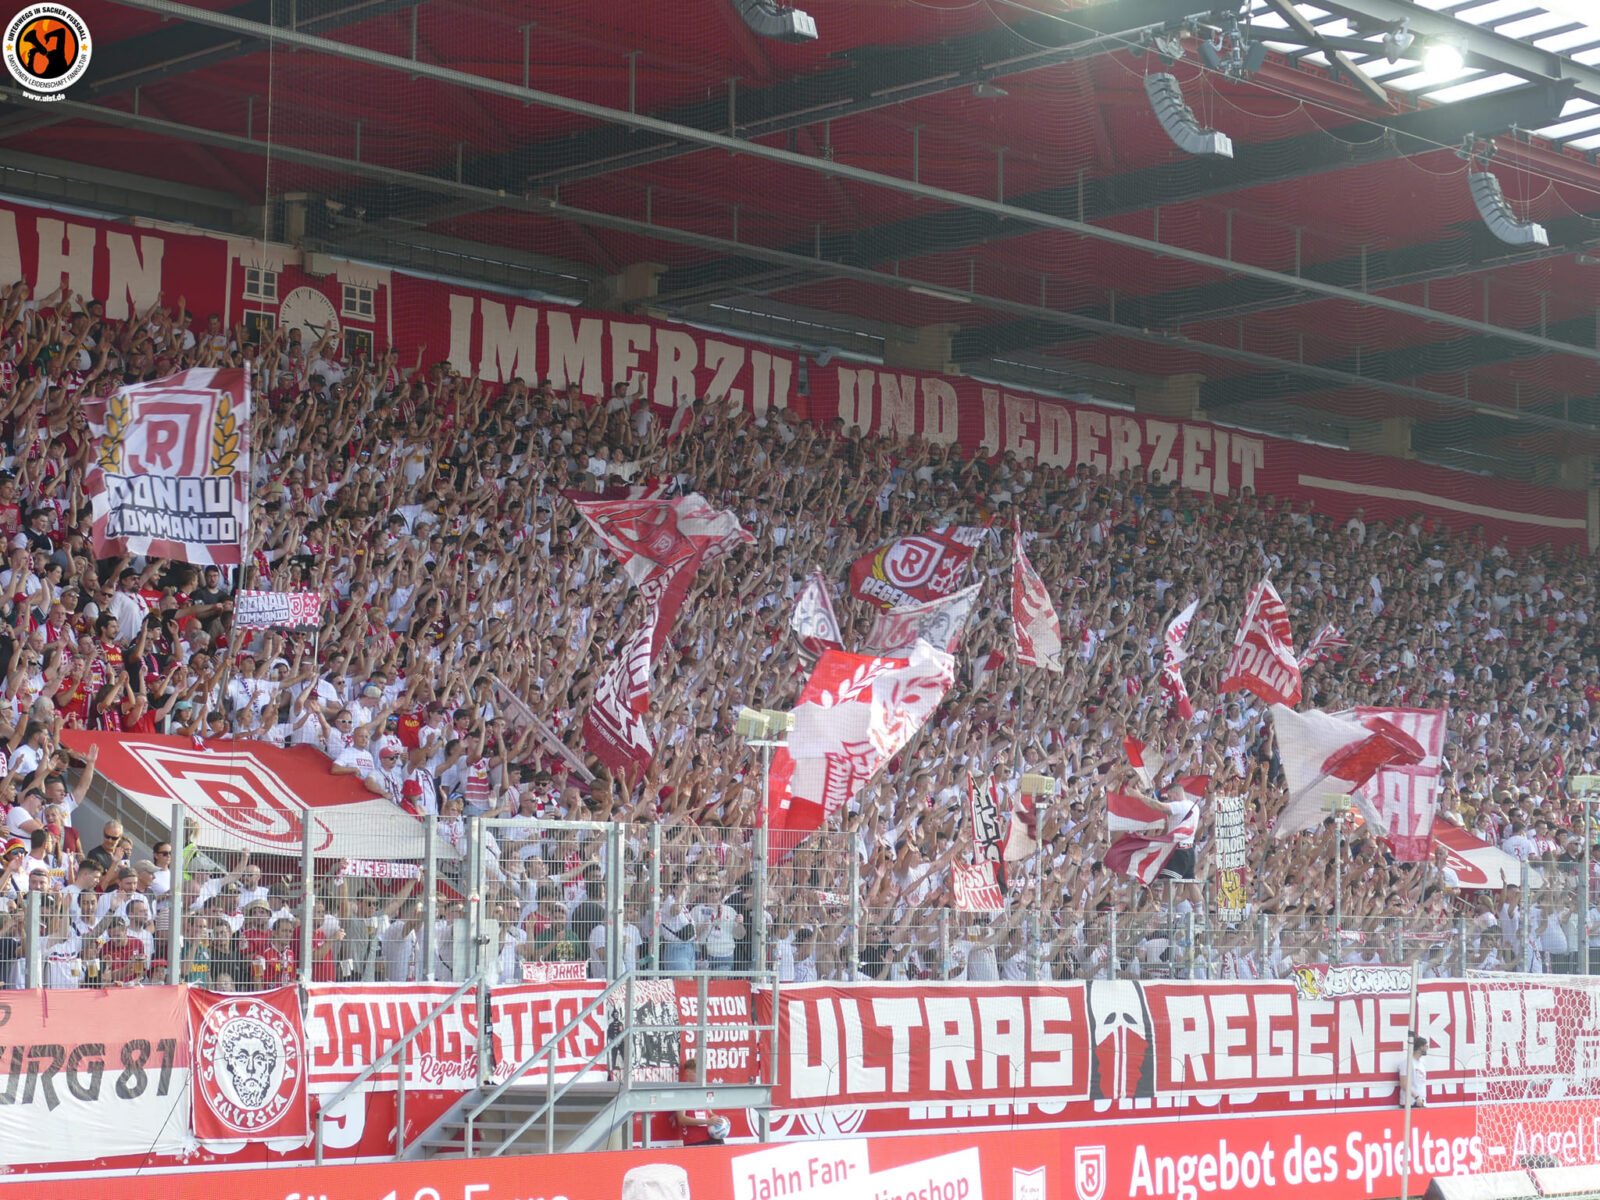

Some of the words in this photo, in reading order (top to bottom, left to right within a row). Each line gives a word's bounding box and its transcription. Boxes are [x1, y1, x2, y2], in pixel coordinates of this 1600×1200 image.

[448, 294, 793, 420] IMMERZU
[838, 366, 959, 447] UND
[979, 388, 1265, 497] JEDERZEIT
[106, 474, 233, 515] DONAU
[552, 964, 585, 979] JAHRE
[789, 995, 1074, 1099] ULTRAS
[1165, 988, 1558, 1083] REGENSBURG
[115, 1038, 177, 1099] 81
[214, 1092, 288, 1127] INVICTA
[748, 1168, 801, 1200] Jahn
[808, 1156, 856, 1188] Fan-
[1129, 1139, 1275, 1200] Angebot
[1284, 1134, 1338, 1184] des
[1345, 1127, 1482, 1193] Spieltags
[1511, 1116, 1588, 1167] Angel
